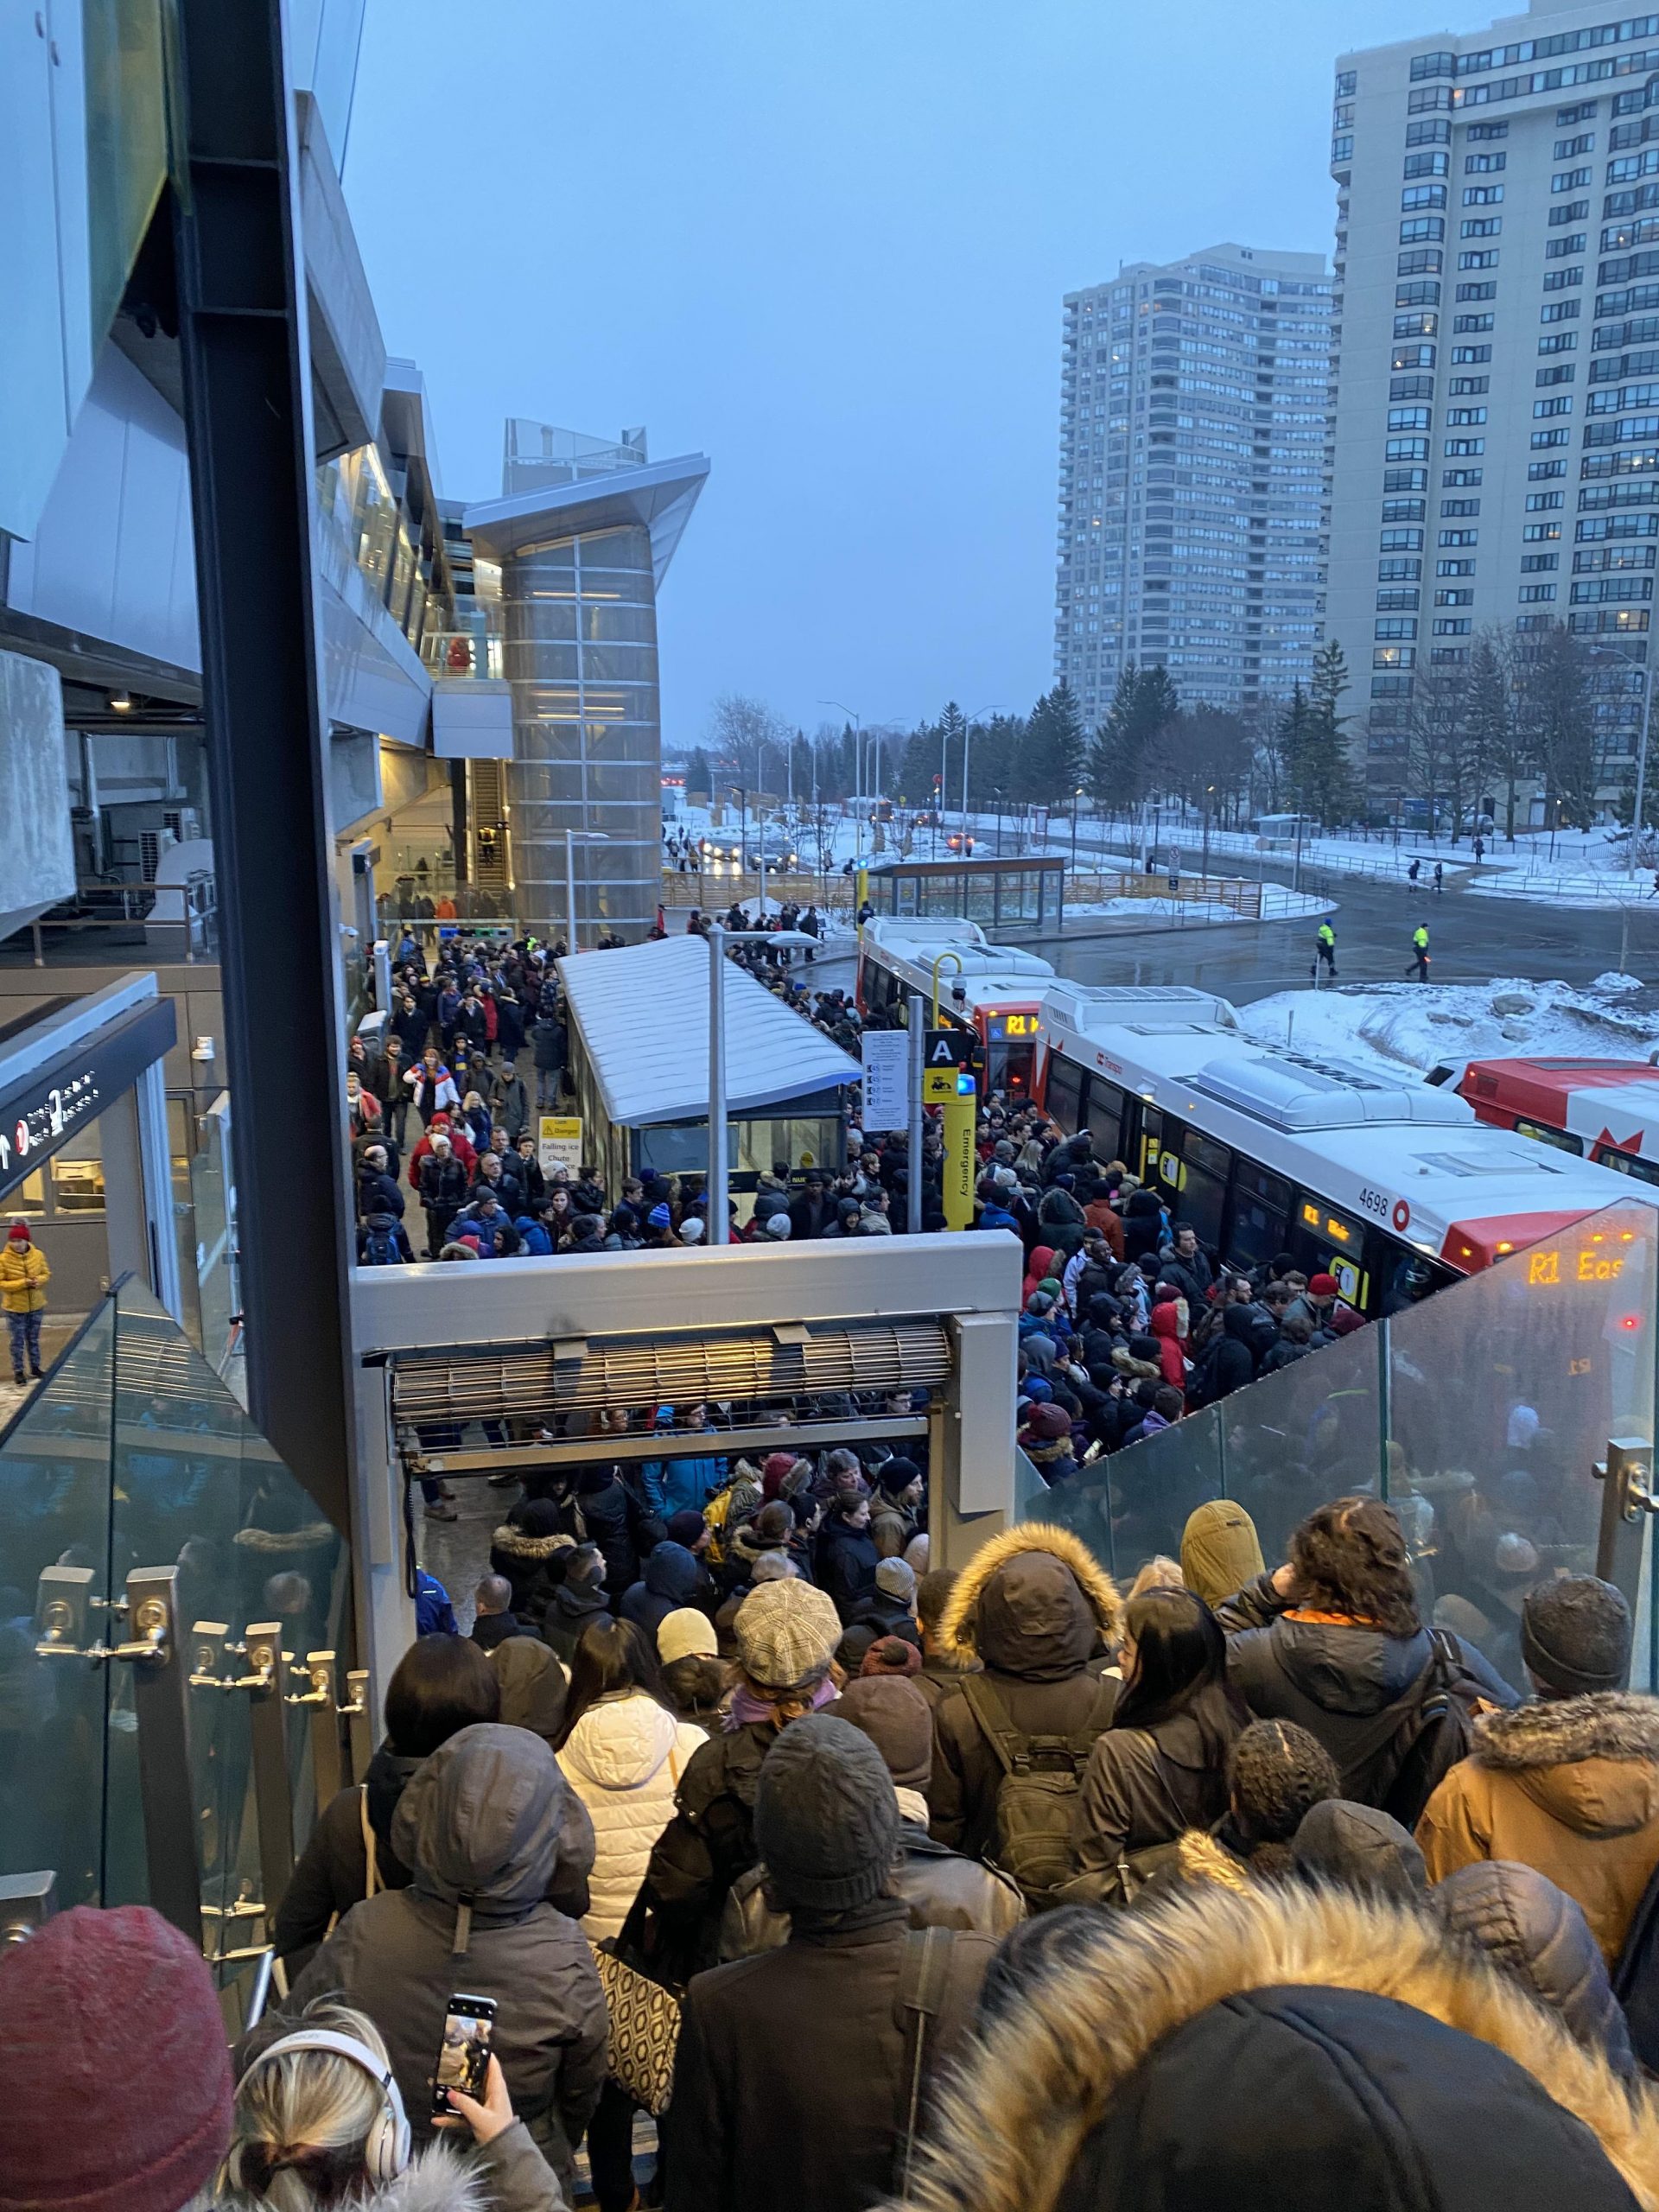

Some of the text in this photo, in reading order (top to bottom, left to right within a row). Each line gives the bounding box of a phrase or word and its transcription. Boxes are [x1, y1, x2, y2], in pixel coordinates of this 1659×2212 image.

[1007, 1015, 1027, 1034] R1
[931, 1039, 953, 1061] A
[960, 1128, 971, 1197] Emergency
[1359, 1187, 1389, 1217] 4698
[1529, 1251, 1625, 1284] R1 Eas
